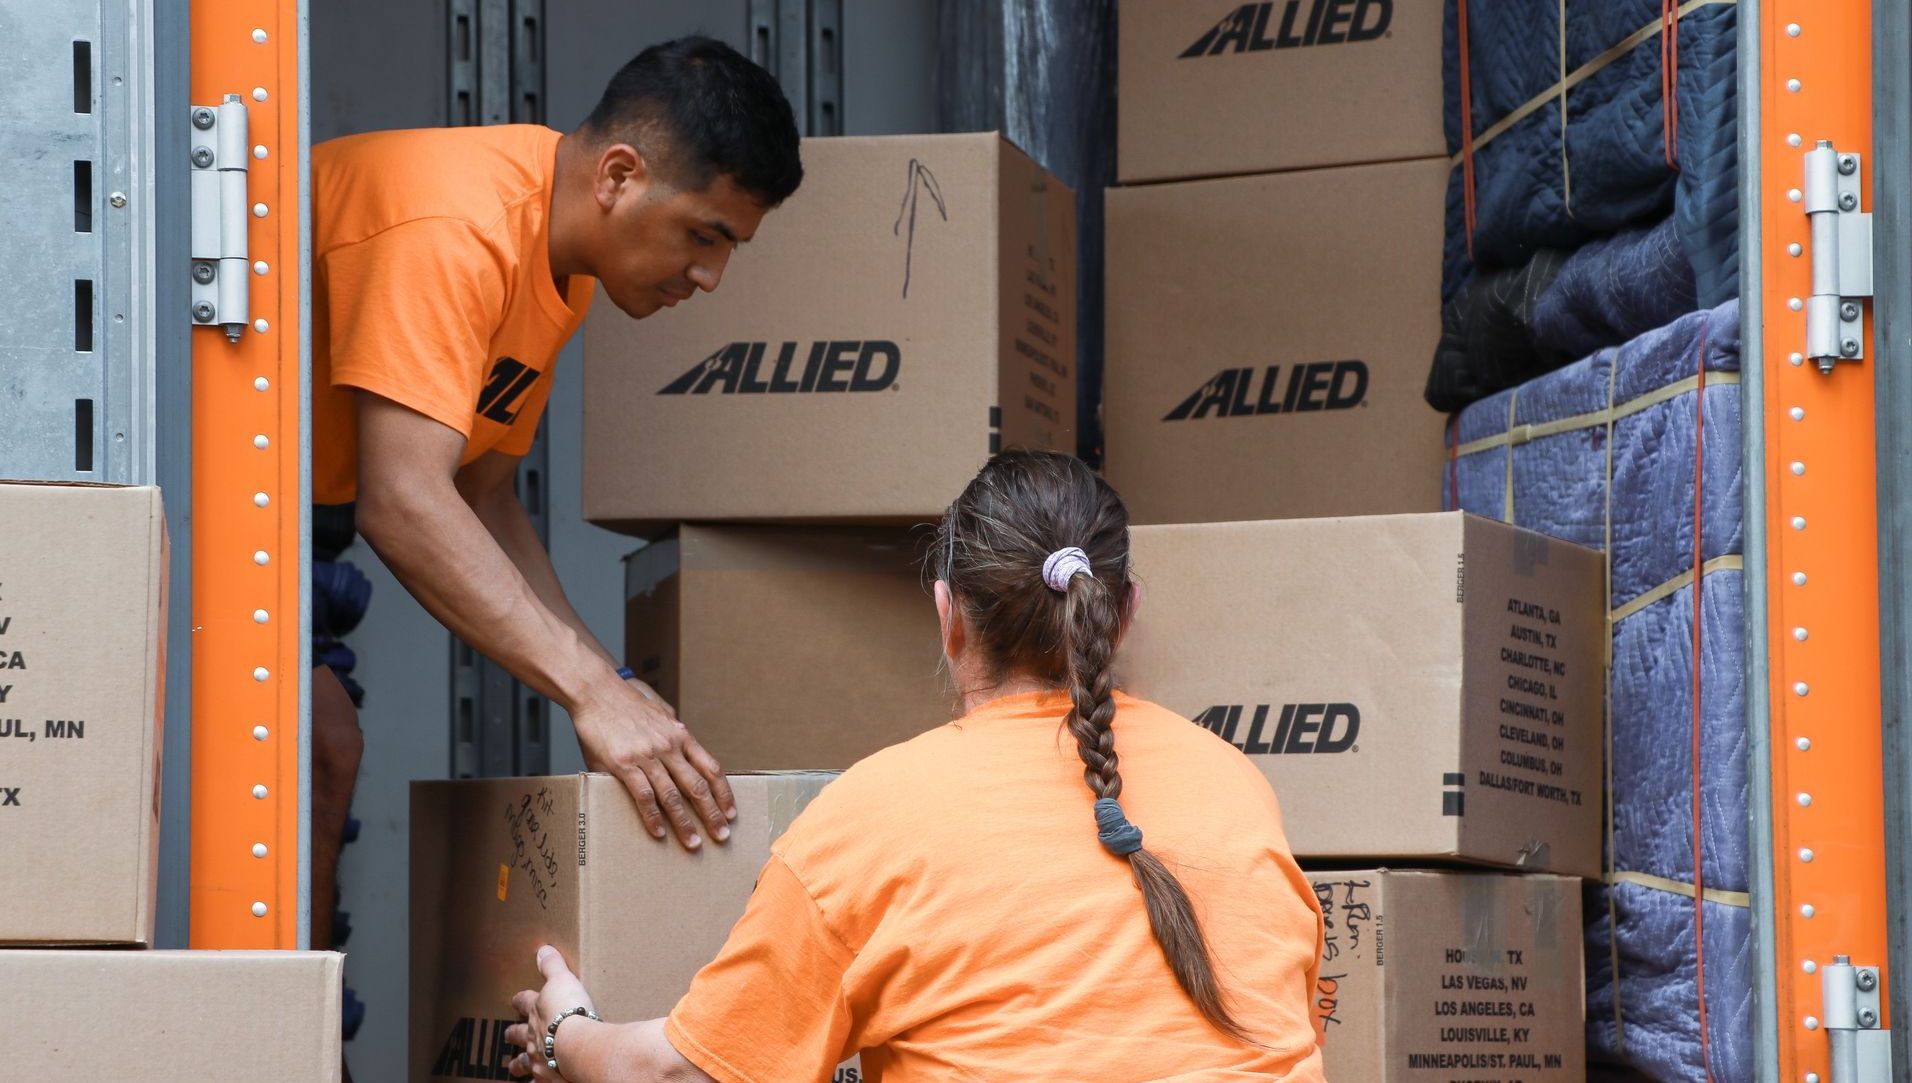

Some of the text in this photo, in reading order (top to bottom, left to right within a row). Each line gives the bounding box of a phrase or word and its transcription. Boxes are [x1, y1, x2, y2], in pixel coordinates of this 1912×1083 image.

[1177, 0, 1393, 59] ALLIED
[655, 341, 901, 395] ALLIED
[1161, 360, 1369, 422] ALLIED
[1457, 567, 1465, 603] BERGER
[1507, 598, 1561, 625] ATLANTA, GA
[1510, 624, 1557, 649] AUSTIN, TX
[1500, 647, 1566, 677] CHARLOTTE, NC
[1508, 674, 1557, 700] CHICAGO, IL
[1500, 698, 1564, 726] CINCINNATI, OH
[45, 720, 85, 739] MN
[1500, 724, 1564, 751] CLEVELAND, OH
[1501, 750, 1563, 777] COLUMBUS, OH
[0, 787, 21, 806] X
[1537, 782, 1569, 806] WORTH,
[1570, 790, 1582, 806] TX
[1376, 929, 1384, 966] BERGER
[1507, 950, 1523, 965] TX
[1441, 975, 1528, 994] LAS VEGAS, NV
[1435, 1001, 1535, 1018] LOS ANGELES, CA
[432, 1017, 529, 1081] ALLIE
[1441, 1028, 1530, 1045] LOUISVILLE, KY
[1408, 1053, 1562, 1071] MINNEAPOLIS/ST. PAUL, MN
